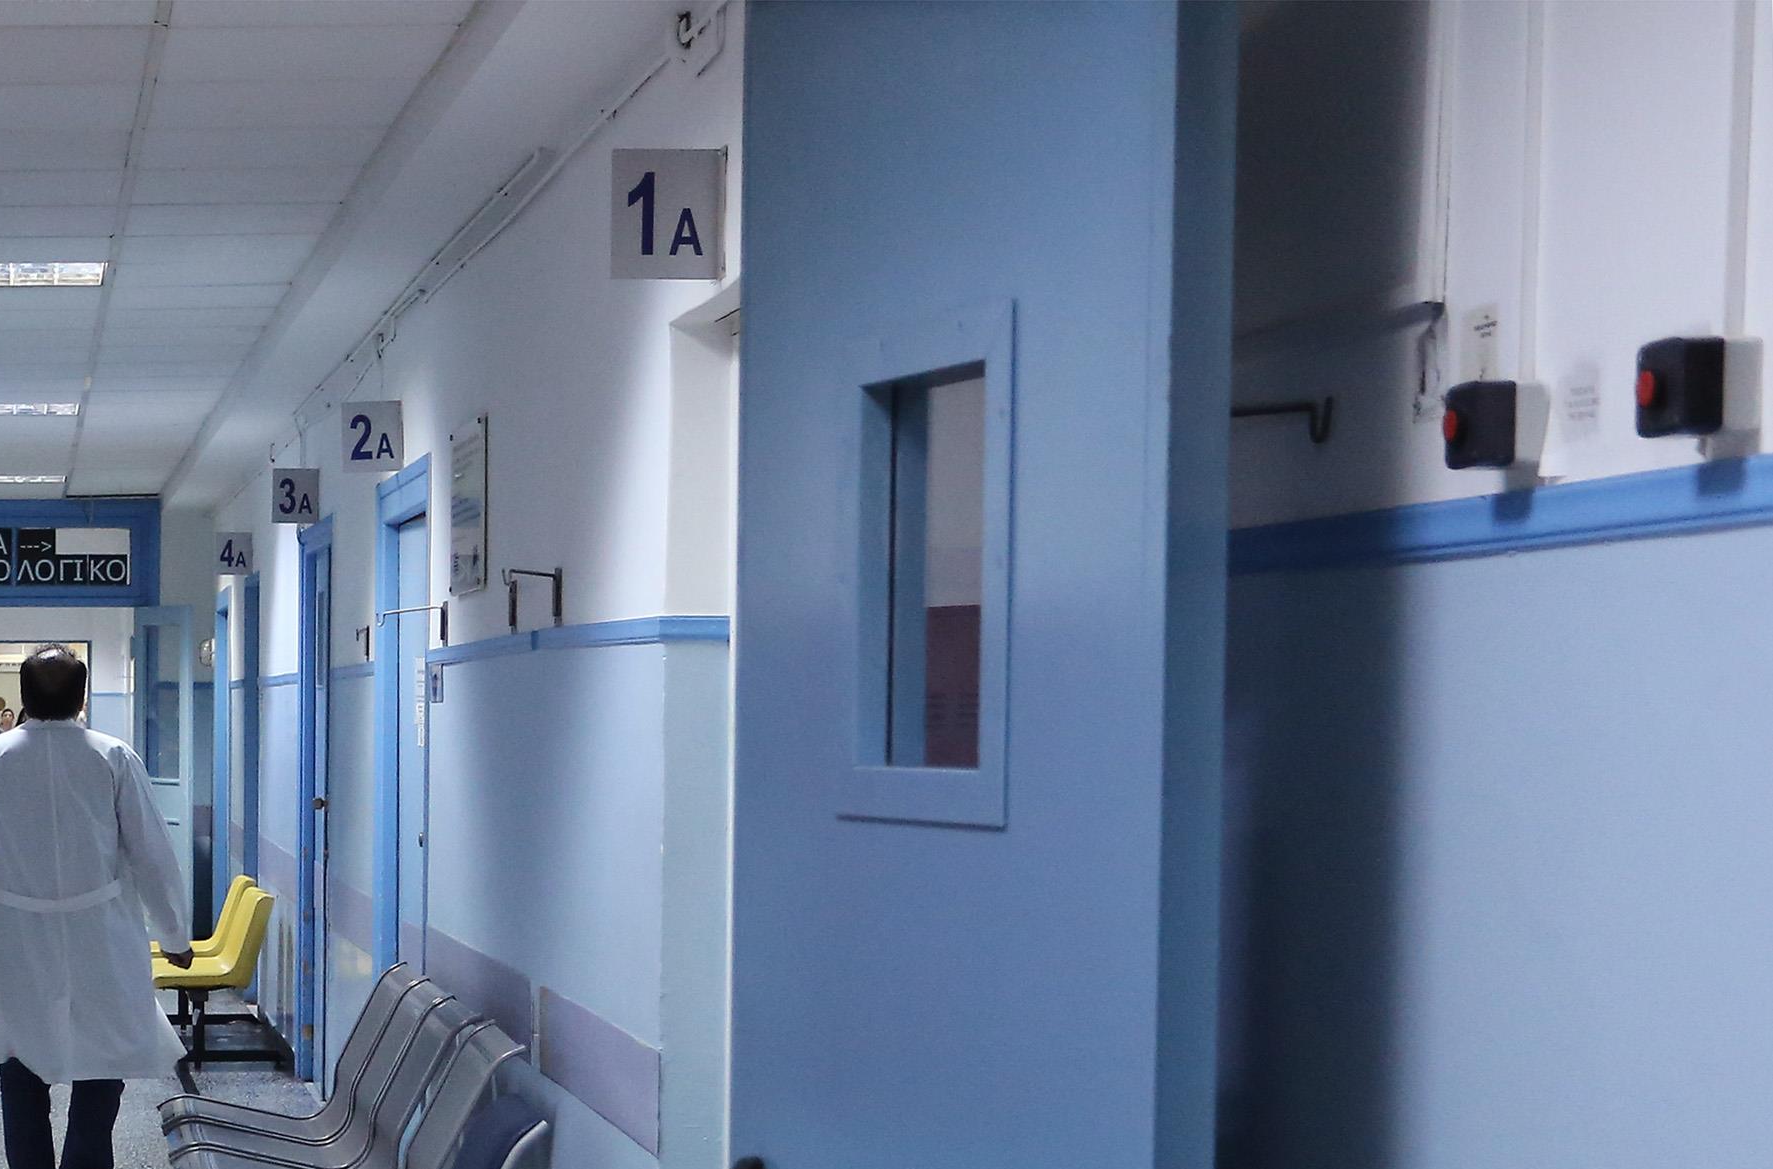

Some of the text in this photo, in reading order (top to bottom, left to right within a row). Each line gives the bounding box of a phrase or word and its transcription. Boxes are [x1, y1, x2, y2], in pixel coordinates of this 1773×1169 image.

[628, 171, 703, 255] 1A
[349, 414, 394, 460] 2A
[279, 478, 313, 514] 3A
